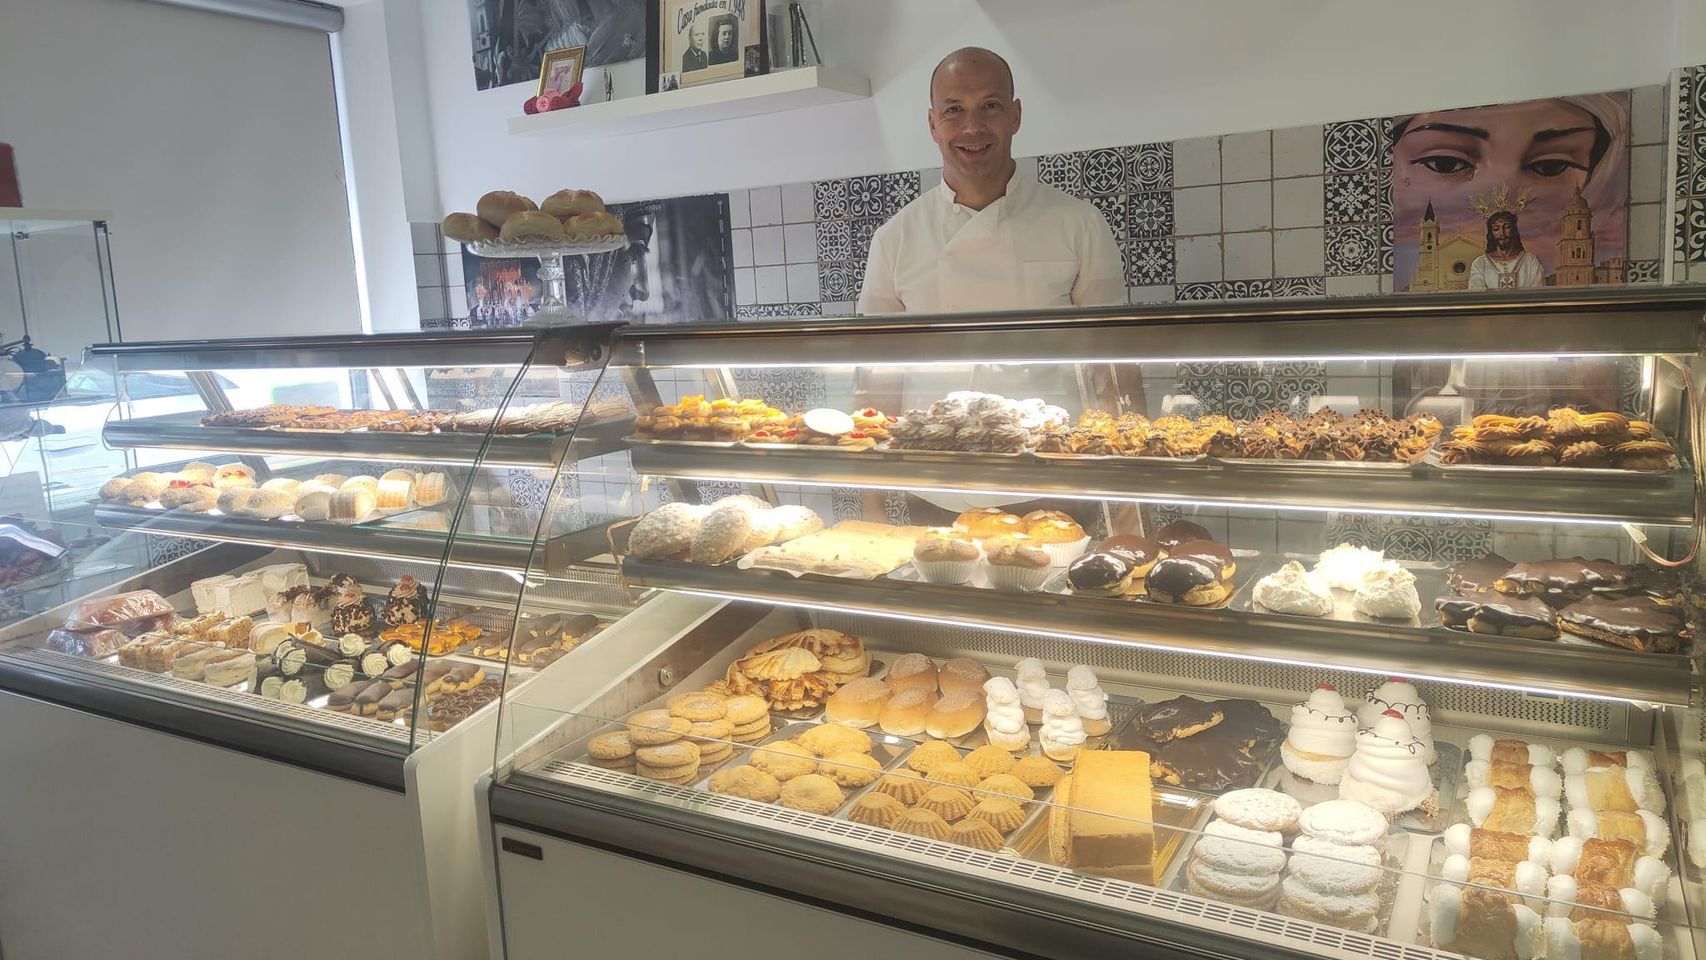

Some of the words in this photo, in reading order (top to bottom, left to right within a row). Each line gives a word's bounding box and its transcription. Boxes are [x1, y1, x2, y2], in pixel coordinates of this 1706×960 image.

[677, 7, 692, 35] Casa
[691, 0, 718, 23] fundada
[718, 0, 727, 10] en
